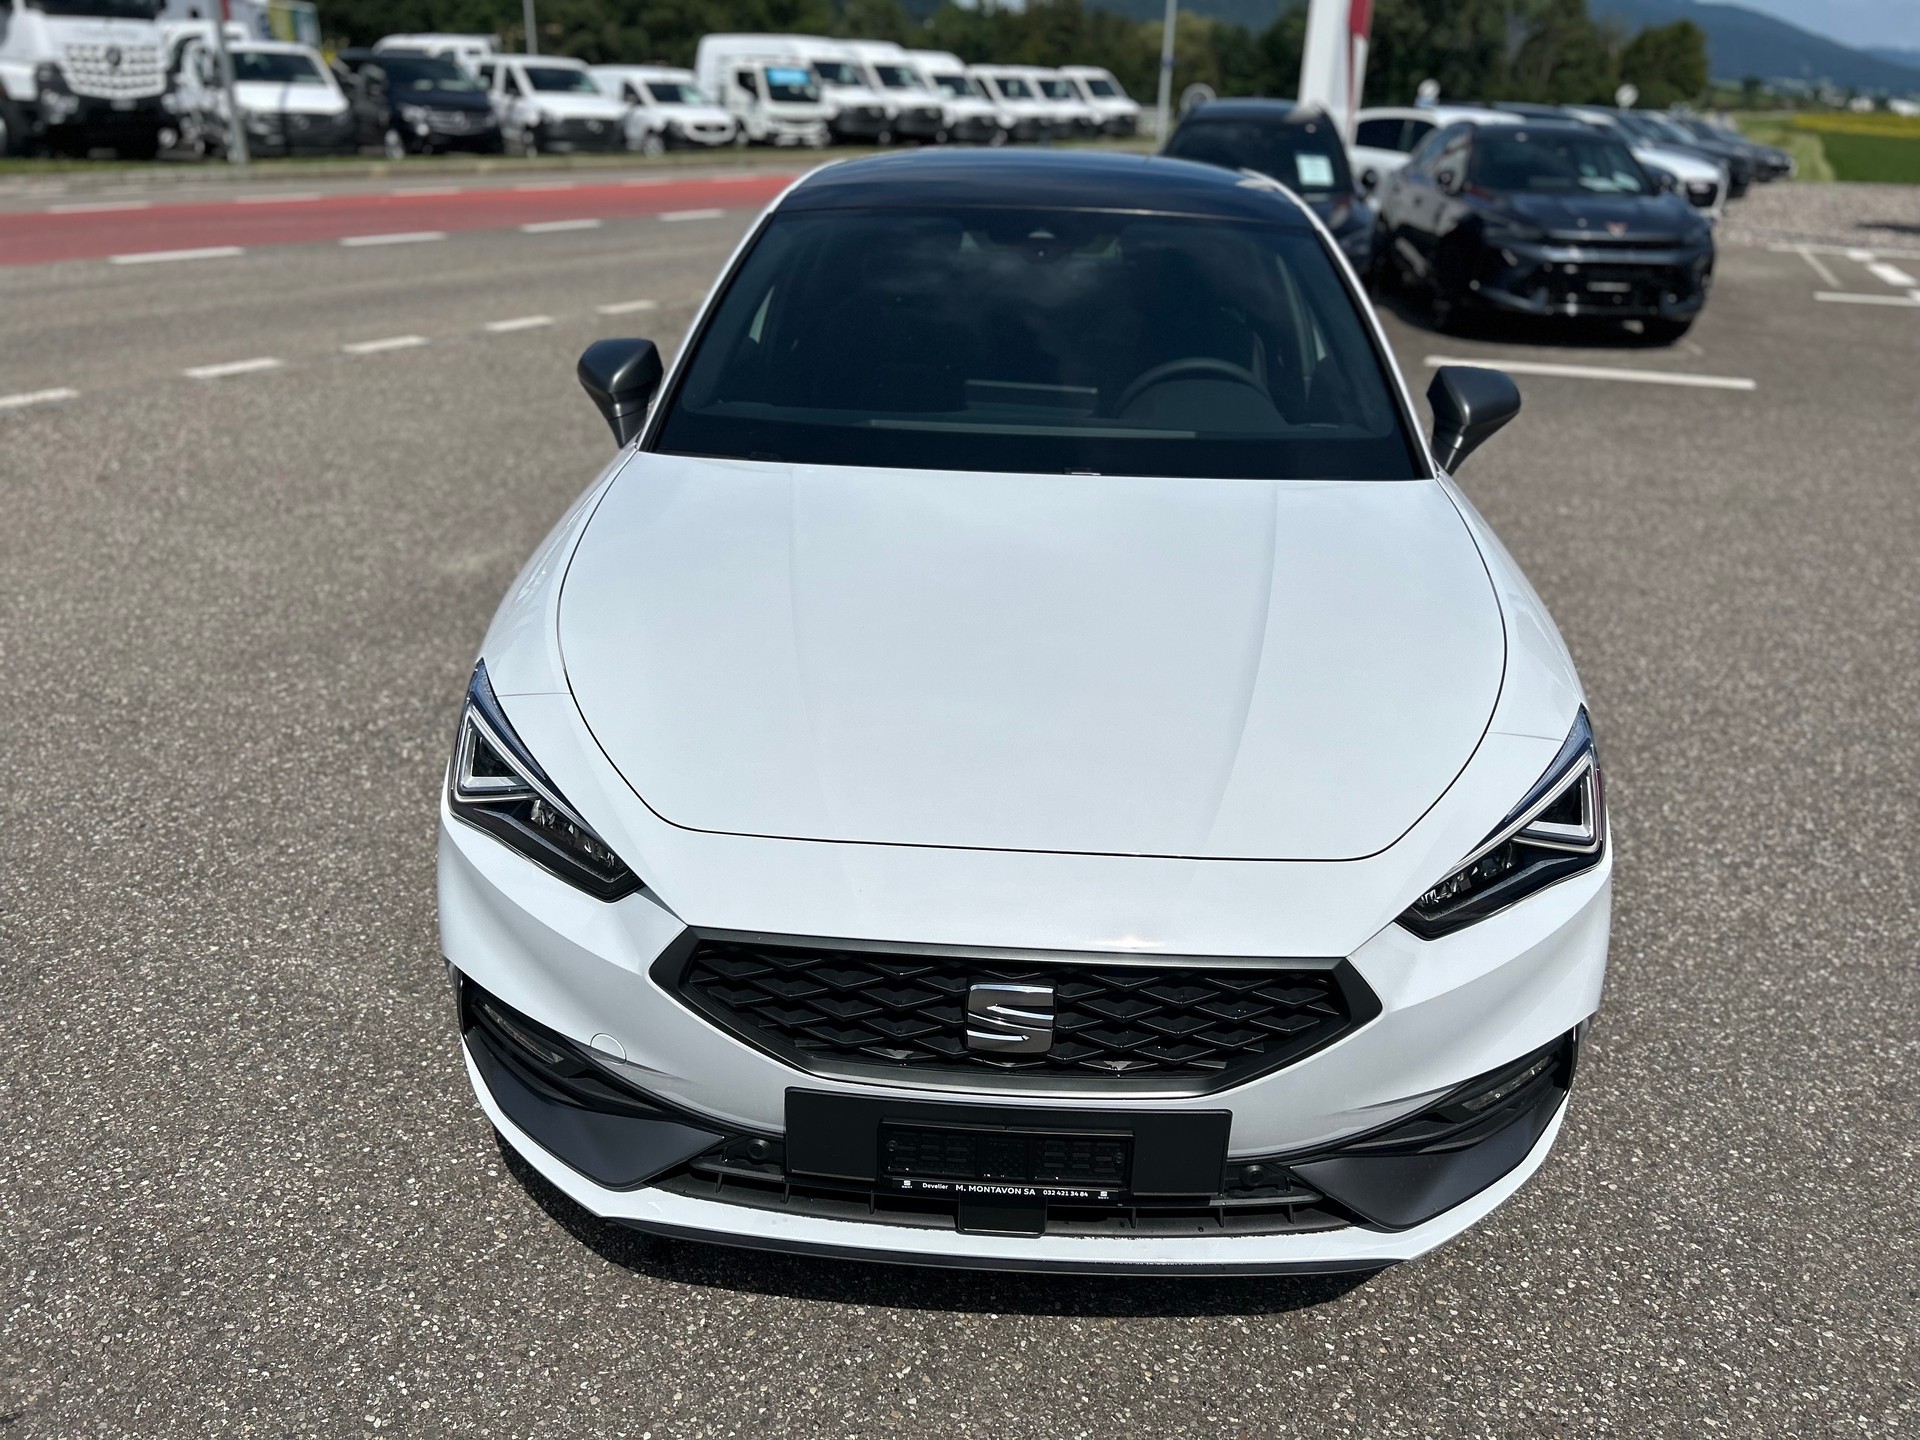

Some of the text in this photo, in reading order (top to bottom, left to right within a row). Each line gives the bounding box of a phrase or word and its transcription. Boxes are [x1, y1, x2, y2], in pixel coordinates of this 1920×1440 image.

[955, 1184, 967, 1192] M.
[968, 1185, 1022, 1195] MONTAVON
[1023, 1188, 1036, 1196] SA
